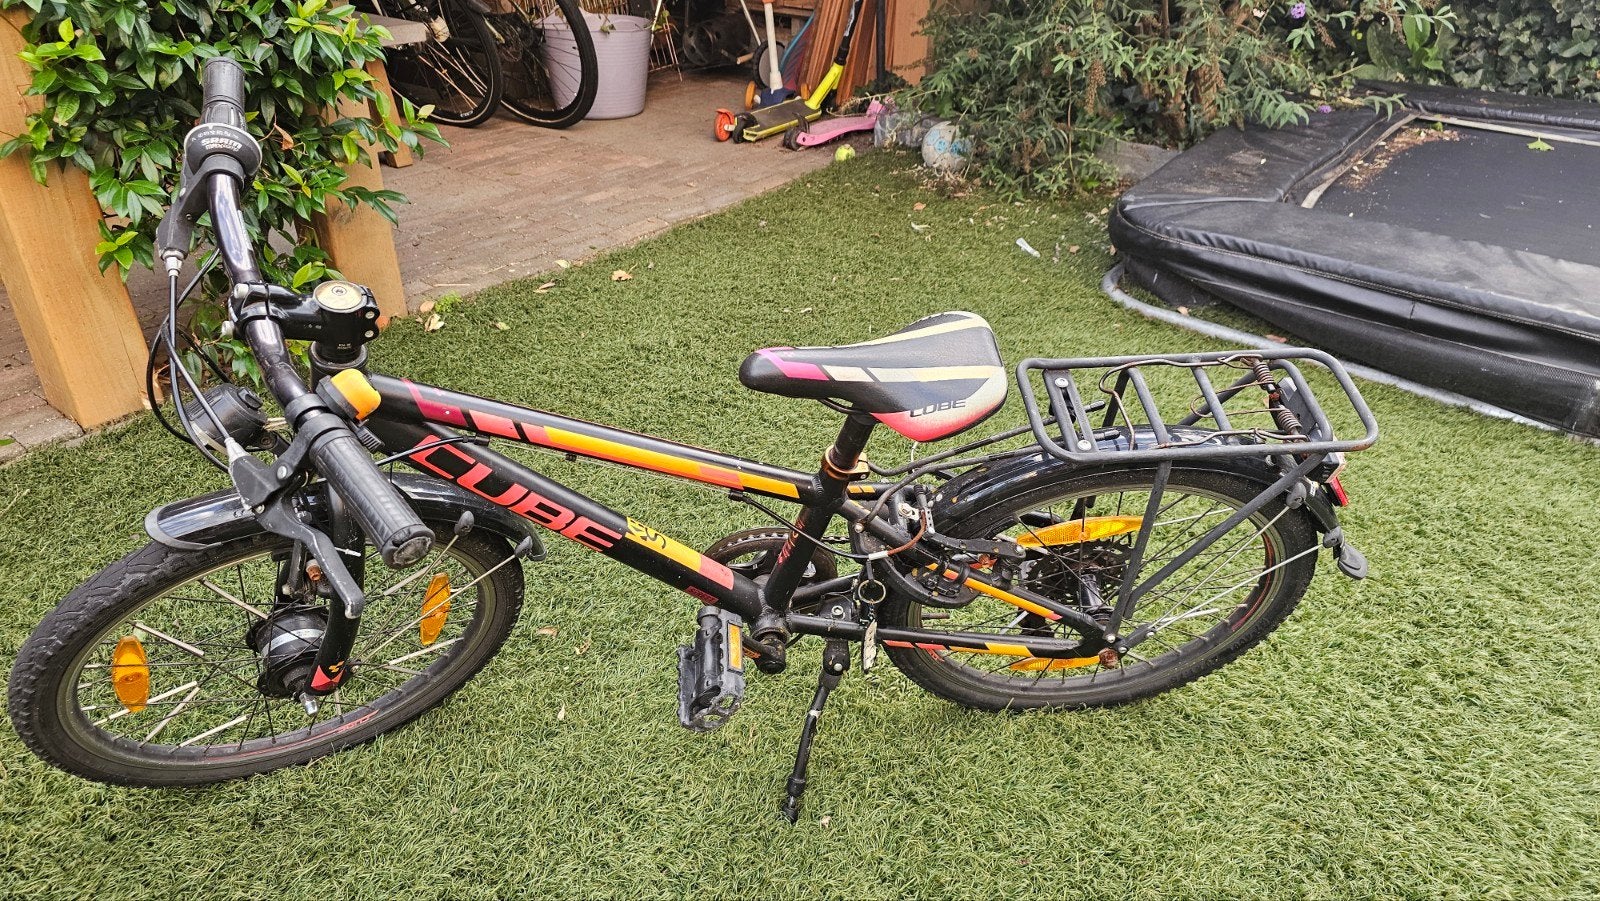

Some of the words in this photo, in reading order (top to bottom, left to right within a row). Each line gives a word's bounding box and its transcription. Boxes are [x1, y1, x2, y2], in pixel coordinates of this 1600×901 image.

[201, 137, 243, 149] SRAM
[909, 400, 966, 418] CUBE
[408, 434, 623, 552] CUBE
